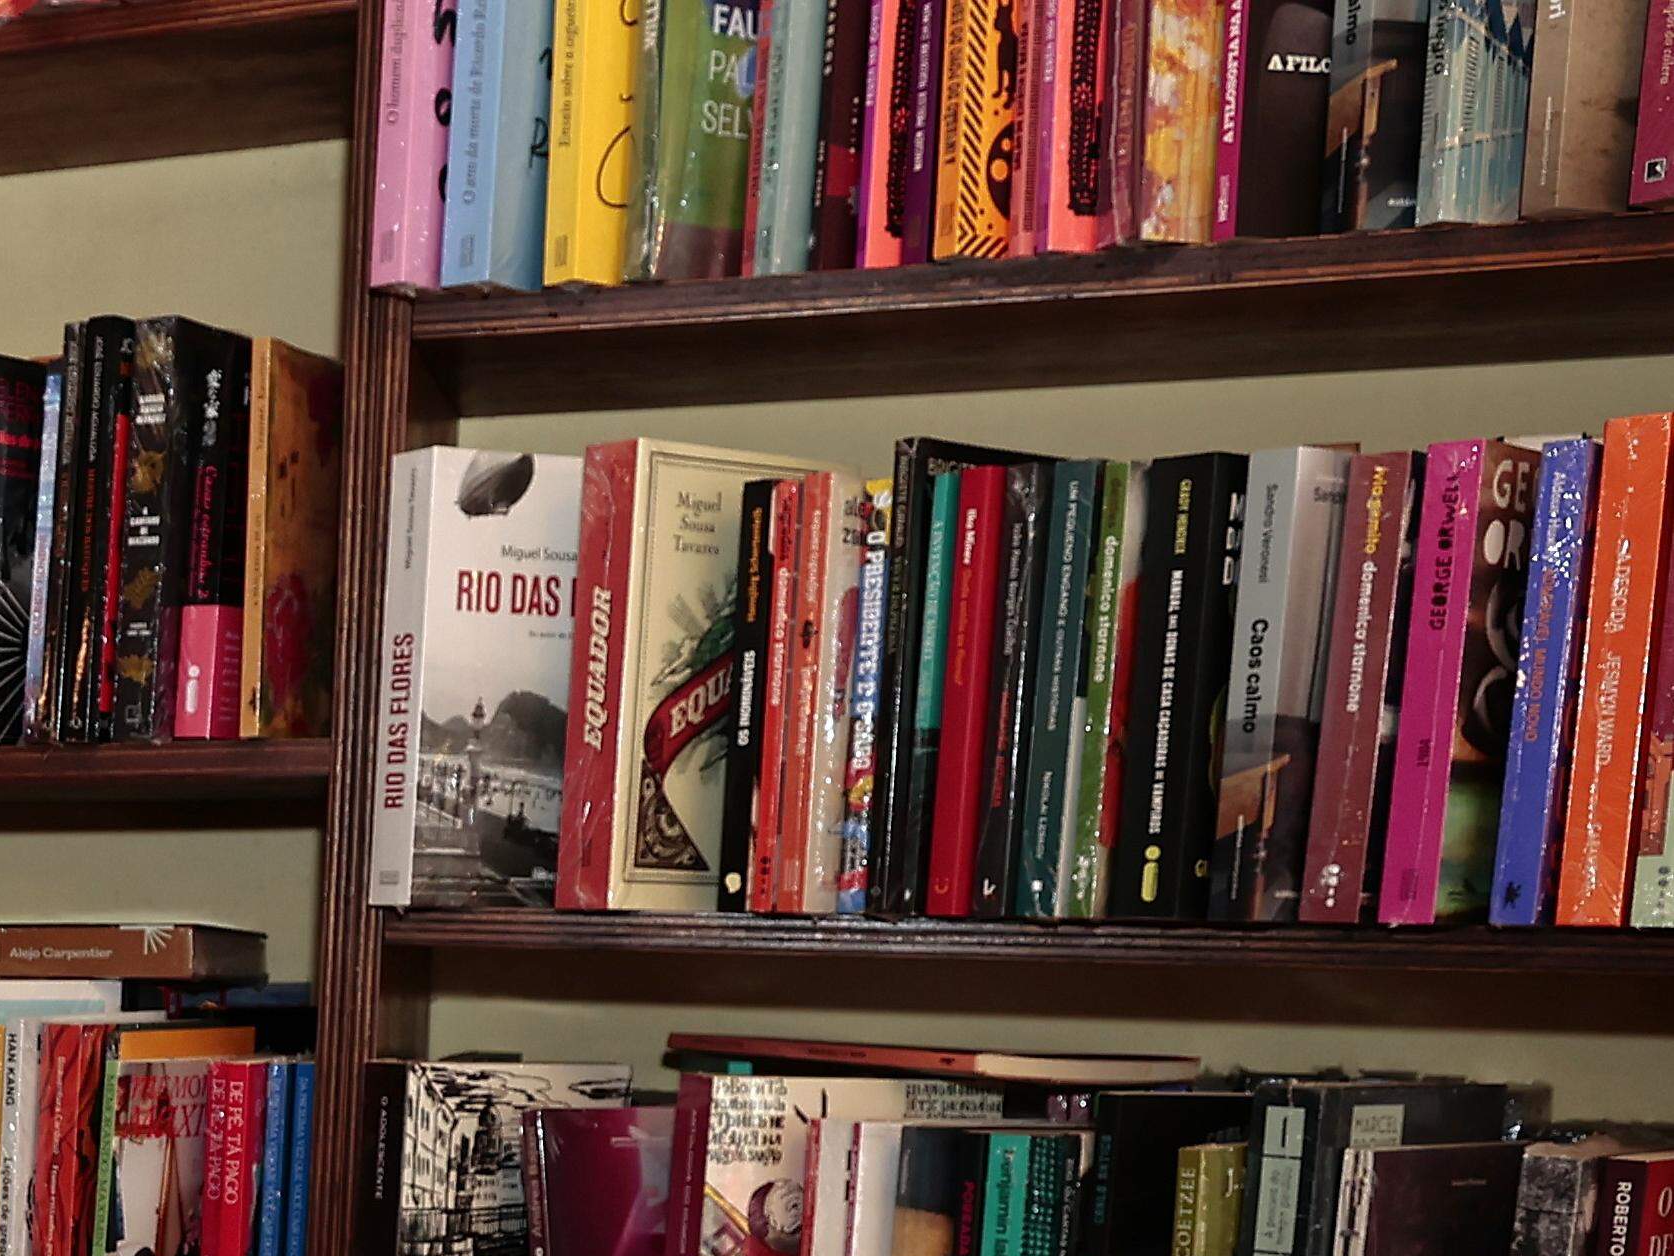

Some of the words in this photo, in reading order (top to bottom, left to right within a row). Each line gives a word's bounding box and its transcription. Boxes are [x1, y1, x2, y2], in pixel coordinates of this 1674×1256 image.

[676, 491, 723, 516] Miguel
[680, 514, 716, 534] Sousa
[500, 544, 541, 563] Miguel
[544, 548, 578, 562] Sousa
[673, 535, 720, 556] Tavares
[457, 569, 500, 612] RIO
[511, 579, 560, 617] DAS
[1099, 536, 1118, 611] domenico
[1430, 555, 1456, 630] GEORGE
[1354, 561, 1378, 639] domenico
[584, 586, 613, 751] EQUADOR
[1094, 615, 1112, 683] starnone
[1248, 619, 1269, 674] Caos
[390, 632, 414, 714] FLORES
[1346, 643, 1368, 712] starnone
[1241, 677, 1260, 733] calmo
[387, 722, 408, 764] DAS
[384, 773, 405, 808] RIO
[10, 946, 43, 961] Alejo
[47, 946, 114, 960] Carpentier
[6, 1033, 17, 1062] HAN
[4, 1068, 16, 1106] KANG
[0, 1204, 10, 1220] de
[1610, 1181, 1632, 1256] ROBERTO
